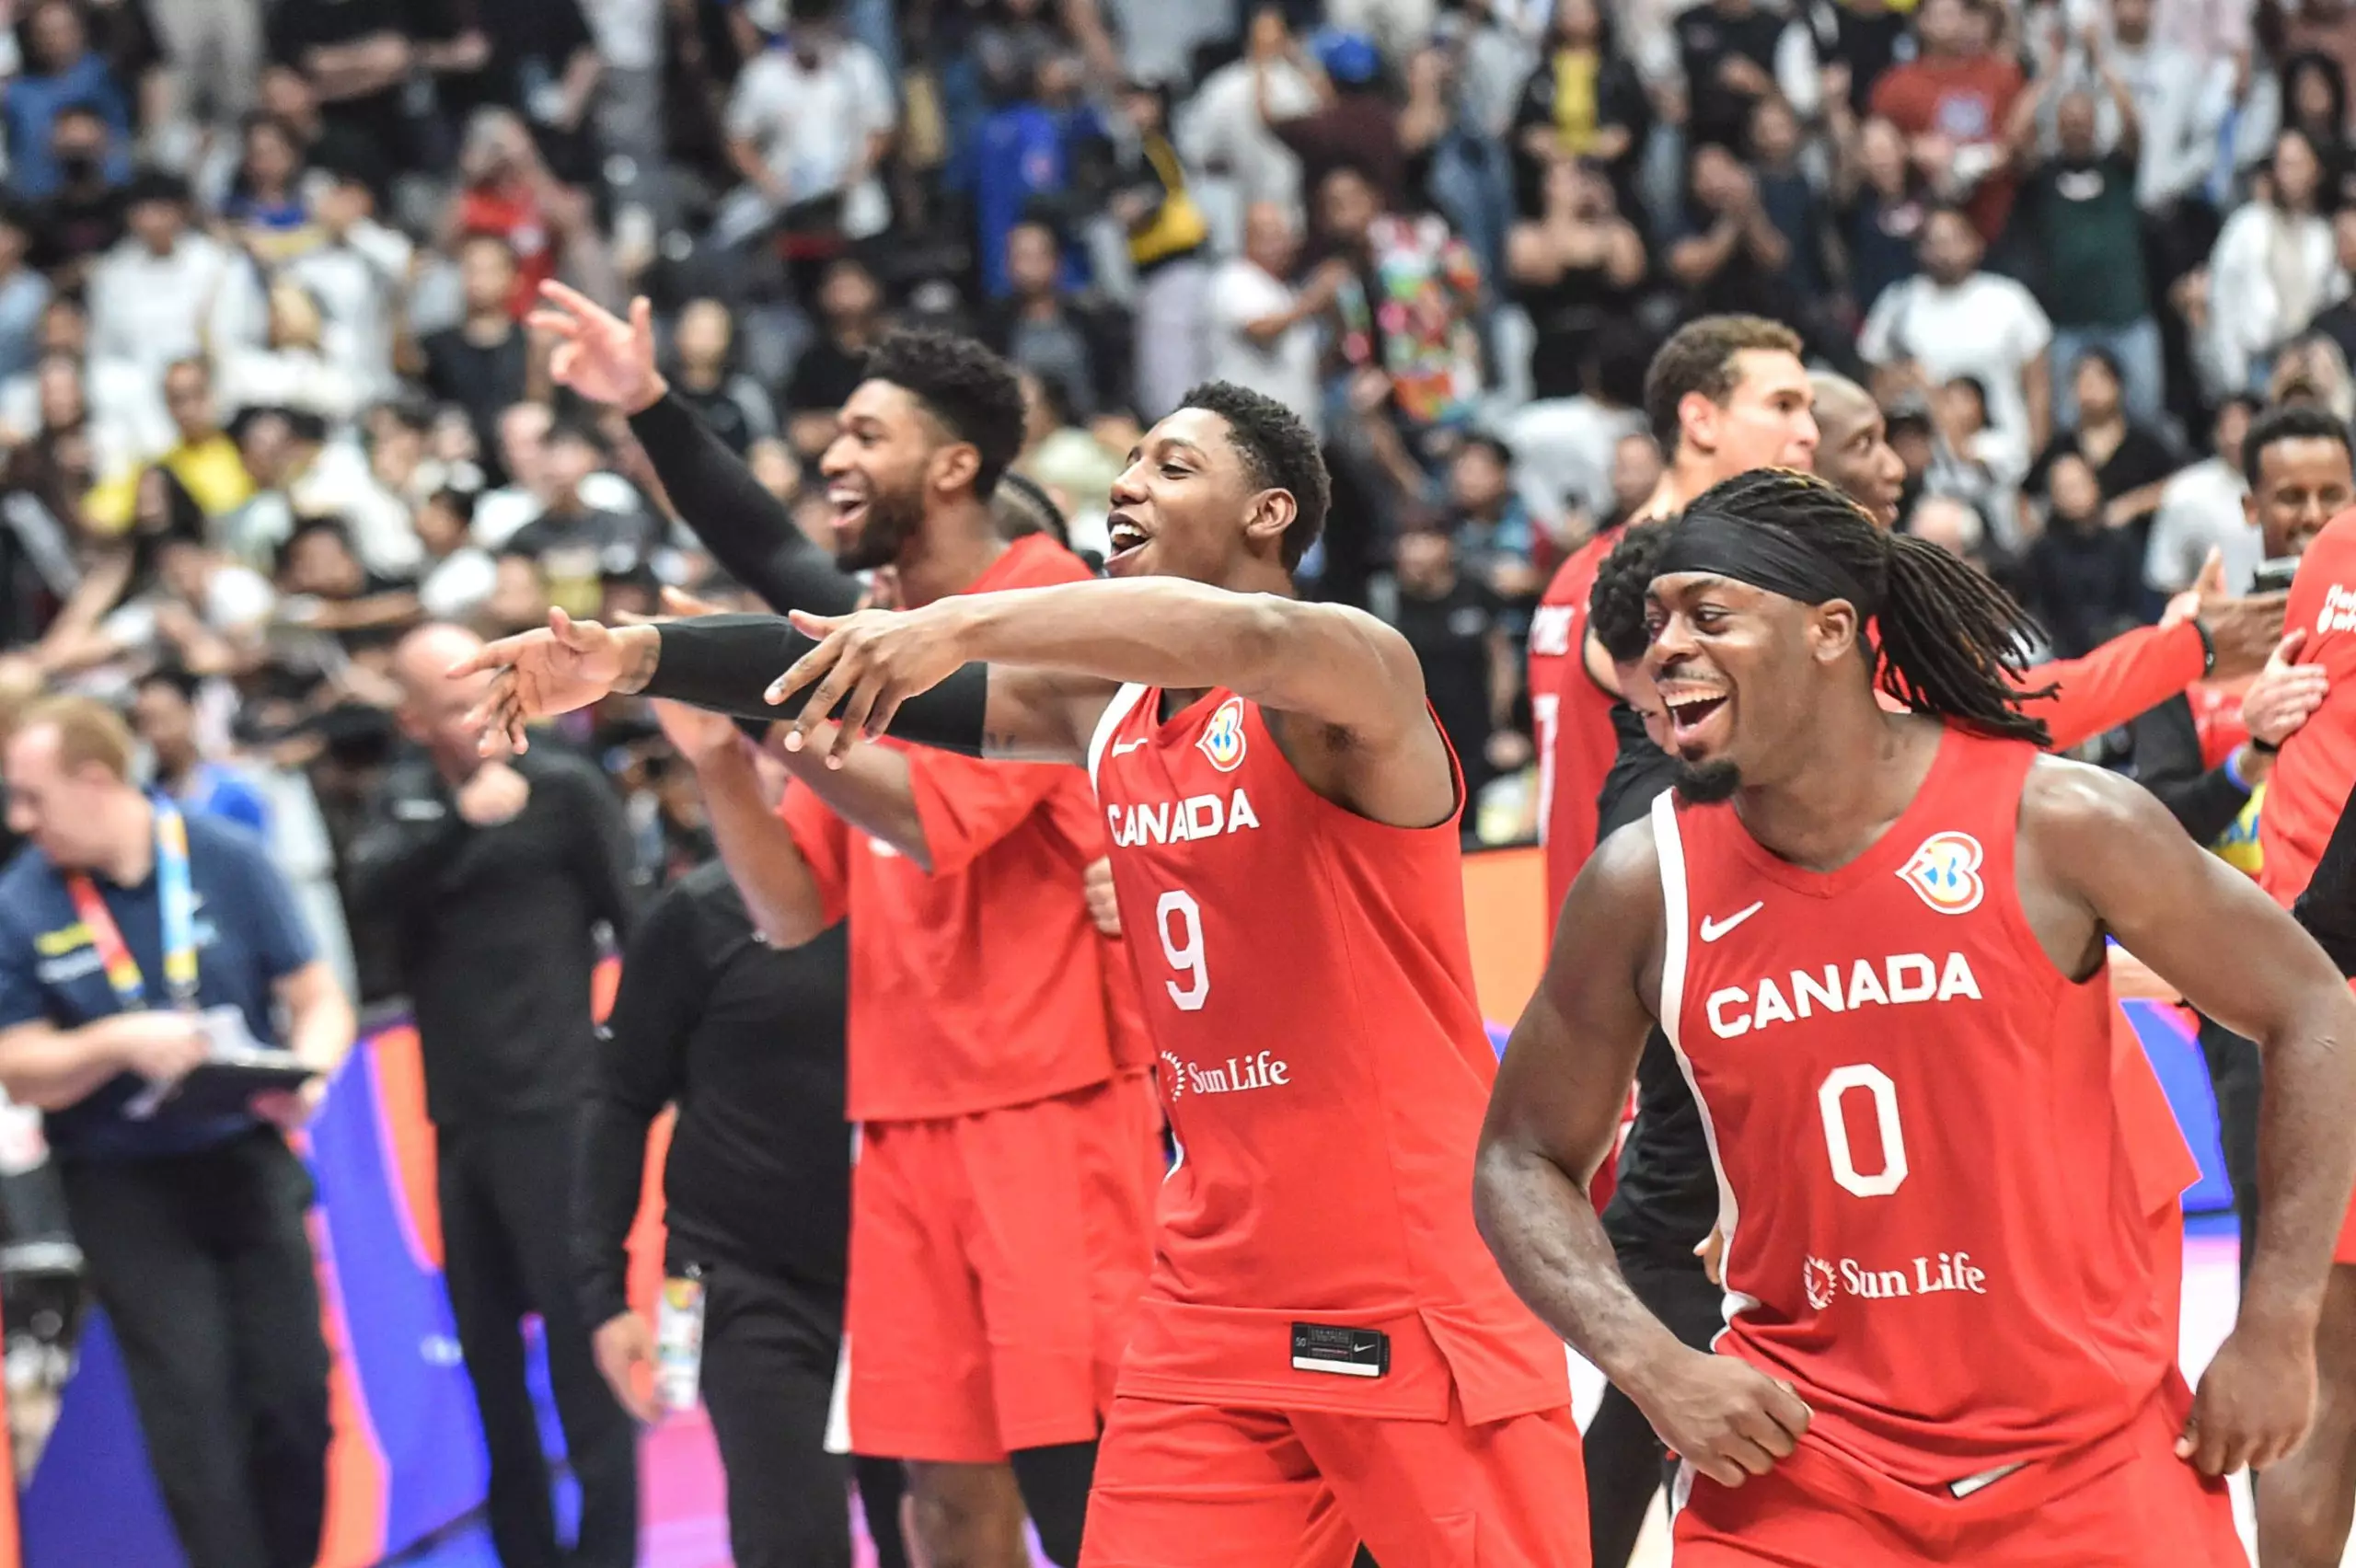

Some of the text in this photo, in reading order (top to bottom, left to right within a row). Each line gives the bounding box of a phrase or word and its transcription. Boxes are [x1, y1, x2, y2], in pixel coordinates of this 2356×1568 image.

[1107, 788, 1260, 847] CANADA
[1156, 890, 1210, 1010] 9
[1705, 951, 1982, 1039] CANADA
[1187, 1050, 1290, 1093] Sun Life
[1818, 1063, 1909, 1198] 0
[1840, 1251, 1987, 1299] Sun Life
